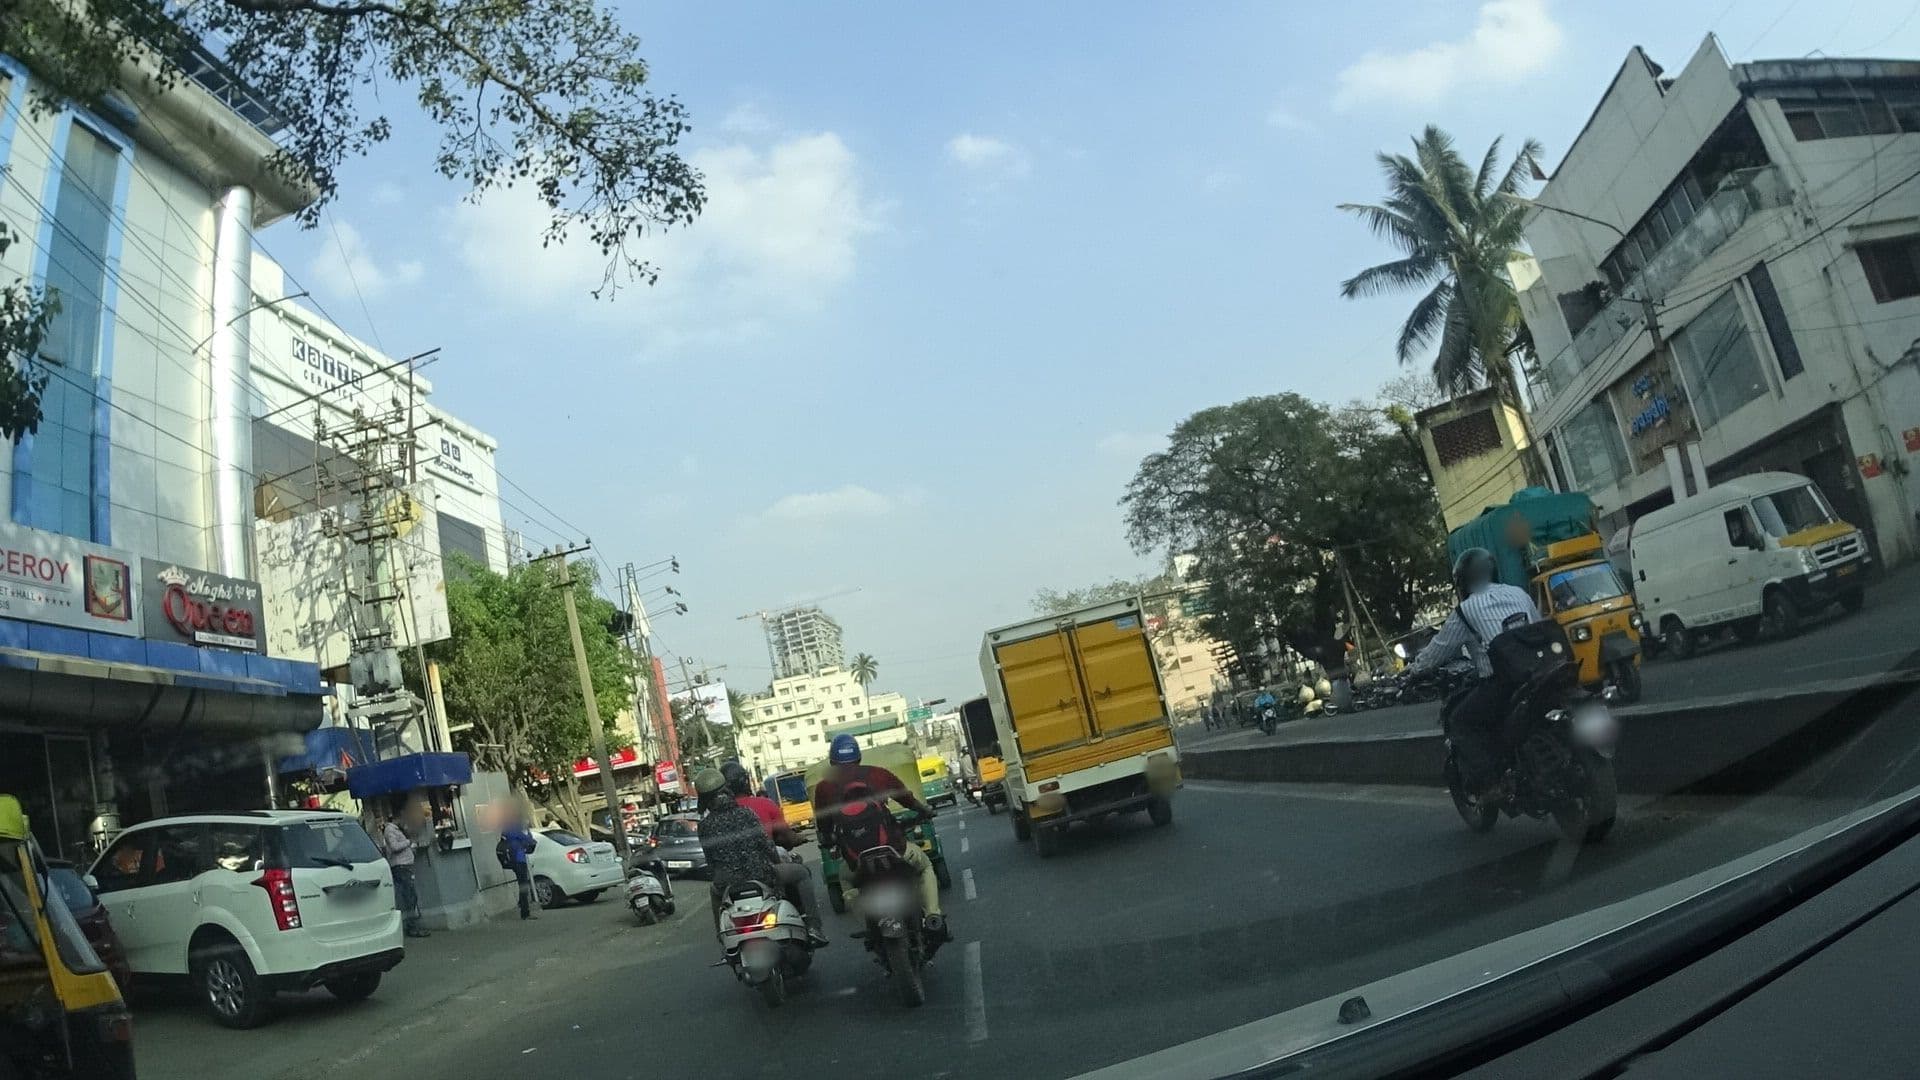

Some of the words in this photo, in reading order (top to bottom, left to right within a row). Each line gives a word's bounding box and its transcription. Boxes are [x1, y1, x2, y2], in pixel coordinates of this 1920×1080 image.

[16, 588, 36, 602] HALL
[187, 575, 233, 602] Night
[164, 584, 255, 637] Queen
